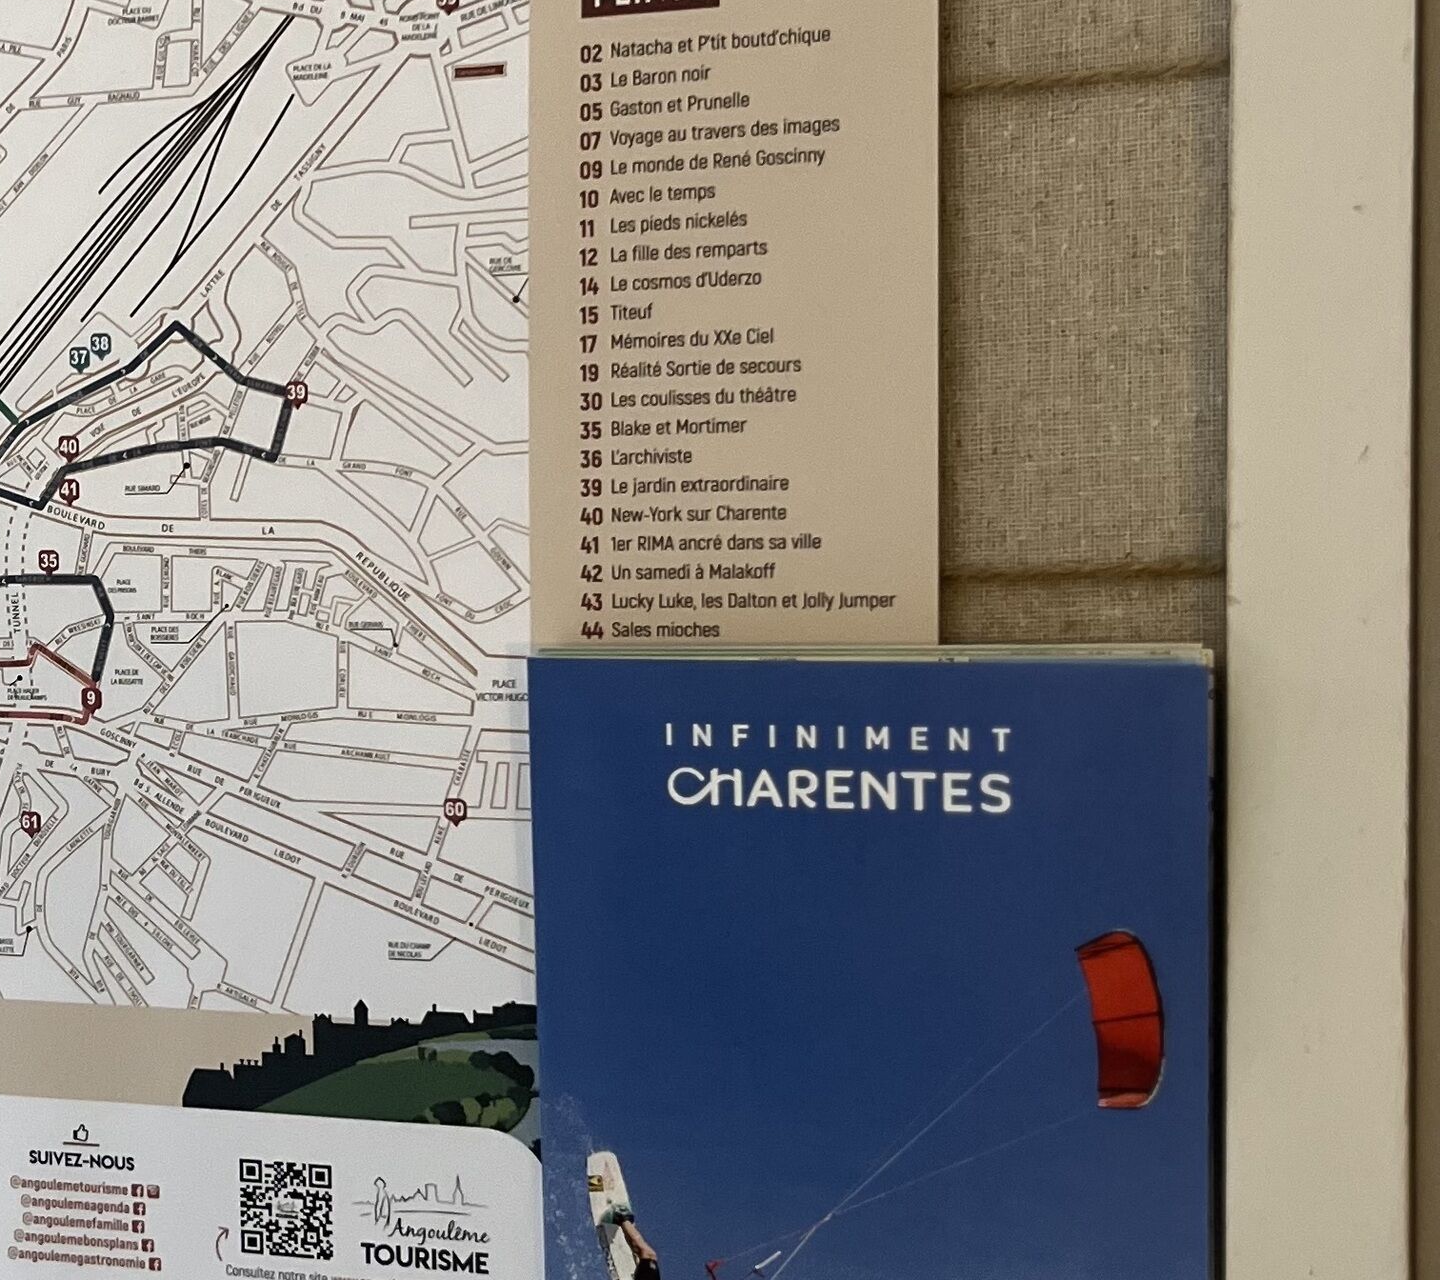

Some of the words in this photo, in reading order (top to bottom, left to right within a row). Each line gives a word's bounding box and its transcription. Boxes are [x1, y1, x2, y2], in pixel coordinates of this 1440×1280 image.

[581, 44, 602, 63] 02
[611, 39, 672, 58] Natacha
[678, 37, 693, 53] et
[580, 73, 602, 92] 03
[611, 72, 627, 88] Le
[633, 70, 676, 86] Baron
[682, 65, 711, 82] noir
[580, 102, 602, 122] 05
[610, 101, 662, 117] Gaston
[667, 98, 682, 113] et
[688, 92, 750, 111] Prunelle
[293, 142, 327, 182] TASSIGNY
[580, 160, 602, 179] 09
[611, 160, 627, 175] Le
[632, 155, 684, 173] monde
[689, 154, 708, 170] de
[713, 151, 751, 169] René
[756, 147, 825, 166] Goscinny
[580, 219, 594, 238] 11
[611, 218, 636, 233] Les
[641, 214, 680, 235] pieds
[686, 211, 747, 229] nickelés
[580, 277, 599, 296] 14
[611, 276, 628, 292] Le
[632, 276, 691, 291] cosmos
[696, 270, 762, 288] d'Uderzo
[92, 336, 109, 351] 38
[71, 350, 87, 364] 37
[287, 385, 305, 399] 39
[580, 392, 602, 411] 30
[611, 392, 636, 407] Les
[641, 390, 710, 407] coulisses
[715, 388, 734, 404] du
[740, 387, 796, 403] théâtre
[580, 421, 602, 440] 35
[611, 420, 651, 436] Blake
[656, 421, 671, 435] et
[676, 418, 747, 434] Mortimer
[60, 439, 77, 453] 40
[581, 450, 602, 468] 36
[611, 448, 692, 465] L'archiviste
[581, 479, 602, 497] 39
[611, 479, 628, 494] Le
[632, 477, 676, 497] jardin
[681, 475, 789, 493] extraordinaire
[46, 505, 106, 531] BOULEVARD
[161, 523, 174, 534] DE
[580, 507, 603, 525] 40
[611, 506, 682, 522] New-York
[687, 509, 712, 522] sur
[716, 505, 786, 521] Charente
[41, 554, 57, 568] 35
[262, 526, 275, 536] LA
[355, 551, 411, 603] REPUBLIQUE
[580, 564, 603, 582] 42
[612, 565, 631, 580] Un
[636, 564, 690, 580] samedi
[695, 563, 704, 580] à
[709, 562, 775, 579] Malakoff
[581, 593, 602, 611] 43
[612, 593, 654, 612] Lucky
[659, 593, 697, 611] Luke,
[701, 593, 723, 609] les
[728, 593, 777, 608] Dalton
[782, 594, 797, 608] et
[802, 592, 834, 612] Jolly
[838, 592, 896, 611] Jumper
[581, 621, 604, 639] 44
[612, 622, 652, 638] Sales
[656, 622, 720, 638] mioches
[492, 679, 516, 688] PLACE
[87, 691, 95, 705] 9
[476, 691, 503, 702] VICTOR
[666, 723, 1010, 752] INFINIMENT
[668, 767, 1011, 813] CHARENTES
[446, 802, 464, 816] 60
[22, 815, 37, 828] 61
[29, 1149, 136, 1172] SUIVEZ-NOUS
[10, 1174, 129, 1197] @angoulemetourisme
[20, 1193, 130, 1215] @angoulemeagenda
[22, 1211, 129, 1234] @angoulemefamille
[388, 1217, 491, 1246] Angoulême
[13, 1229, 139, 1252] @angoulemebonsplans
[7, 1246, 147, 1270] @angoulemegastronomie
[360, 1241, 490, 1275] TOURISME
[225, 1263, 276, 1280] Consultez
